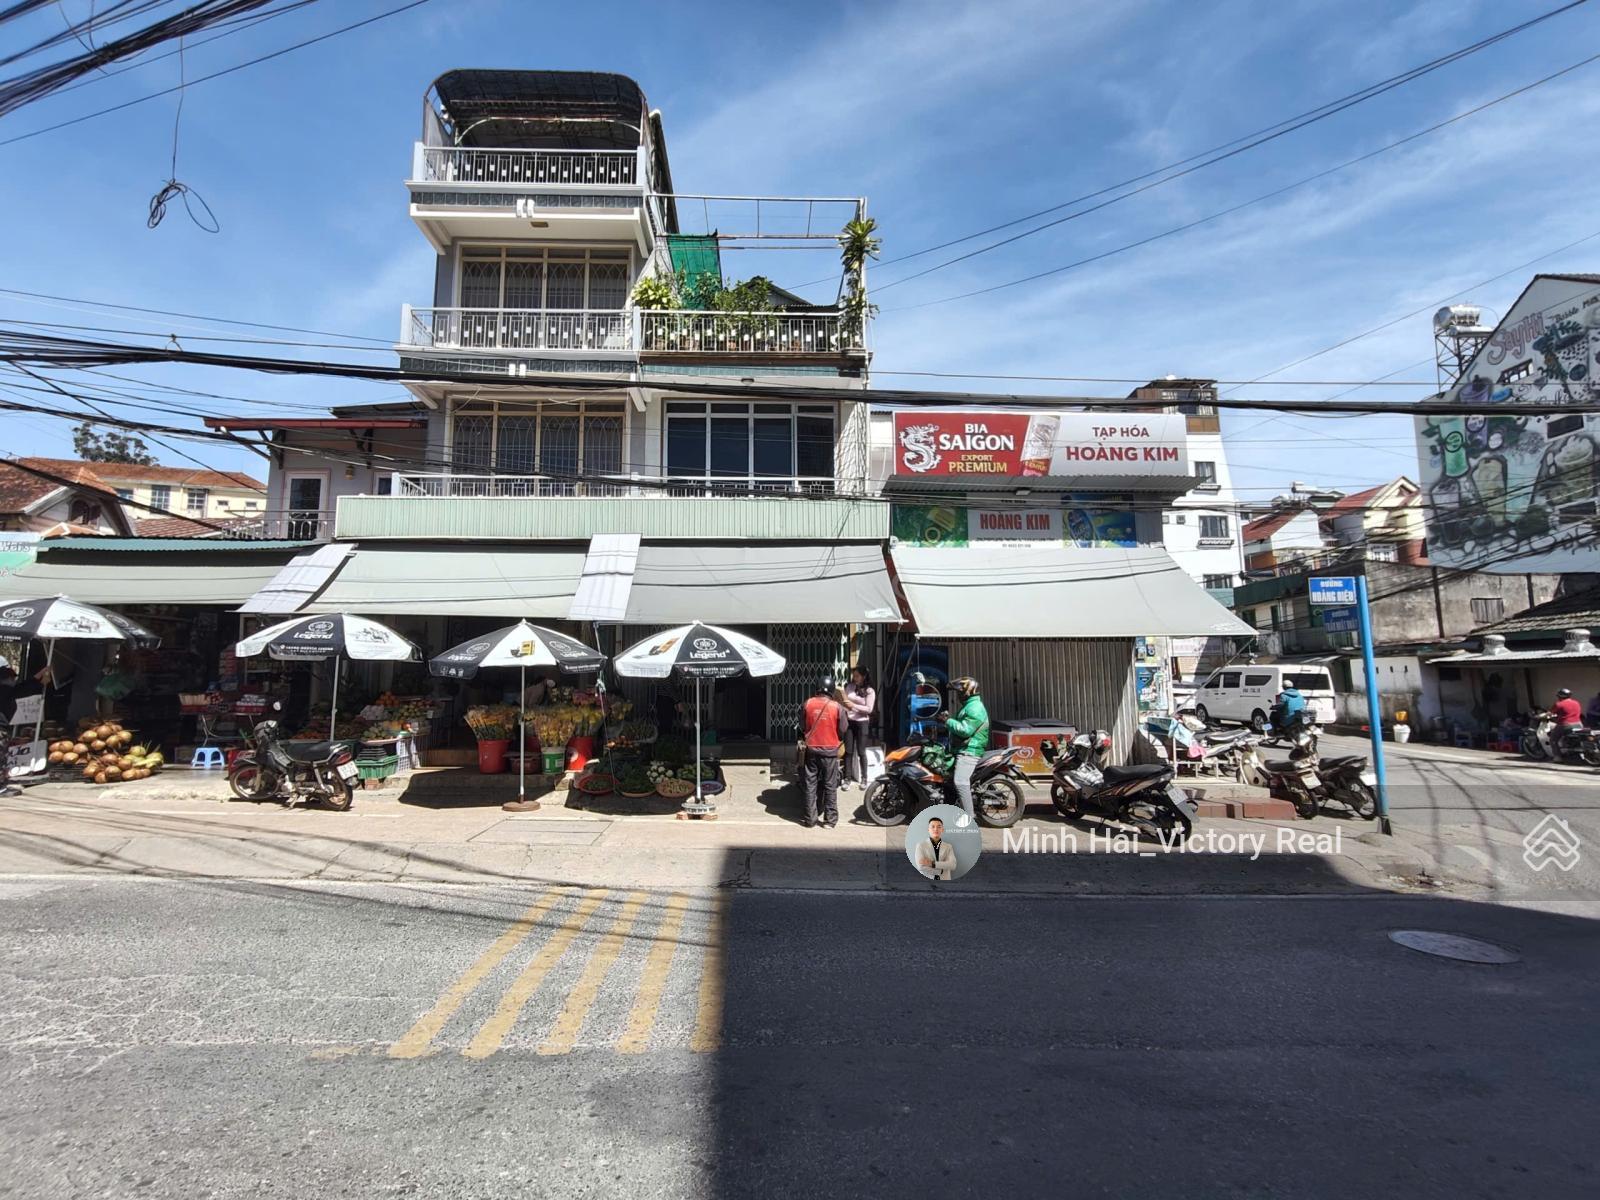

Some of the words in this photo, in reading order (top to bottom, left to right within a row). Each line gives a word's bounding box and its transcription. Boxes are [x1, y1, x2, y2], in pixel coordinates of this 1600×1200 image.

[964, 423, 988, 434] BIA
[1092, 427, 1117, 440] TẠP
[1120, 424, 1150, 437] HÓA
[939, 434, 1014, 451] SAIGON
[1066, 442, 1138, 461] HOÀNG
[1143, 447, 1179, 461] KIM
[948, 462, 1008, 473] PREMIUM
[980, 511, 1022, 530] HOÀNG
[1026, 514, 1050, 530] KIM
[690, 651, 726, 660] Legend
